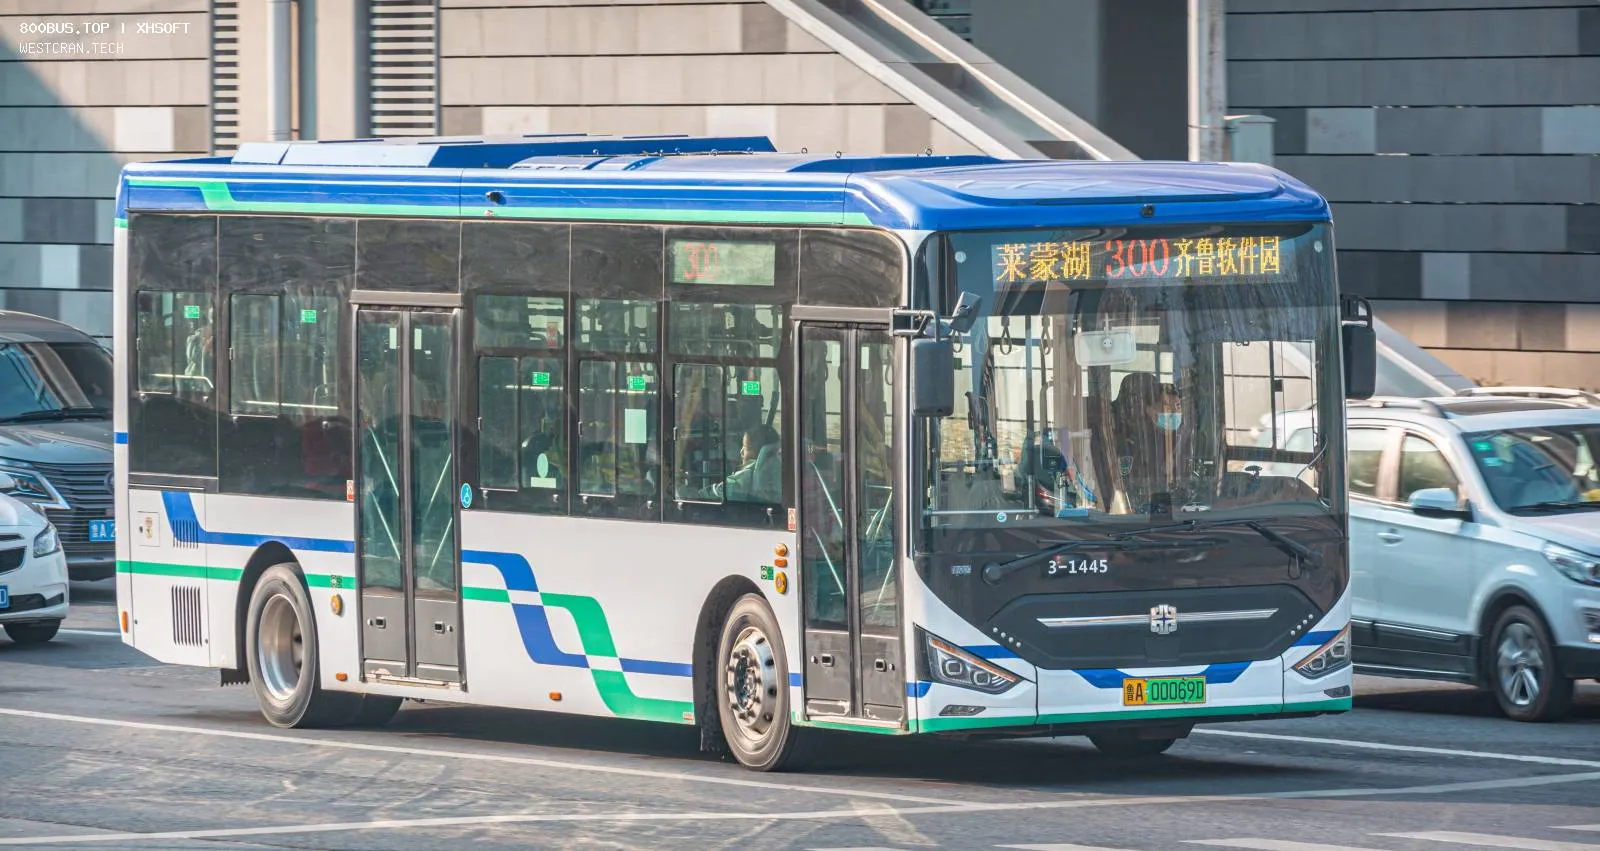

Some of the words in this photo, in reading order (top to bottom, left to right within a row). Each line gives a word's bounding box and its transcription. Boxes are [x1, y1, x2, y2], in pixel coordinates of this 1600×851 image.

[684, 241, 719, 281] 300
[996, 241, 1091, 281] 莱蒙湖
[1105, 238, 1169, 277] 300
[1173, 236, 1280, 277] 齐鲁软件园
[1048, 559, 1108, 575] 3-1445
